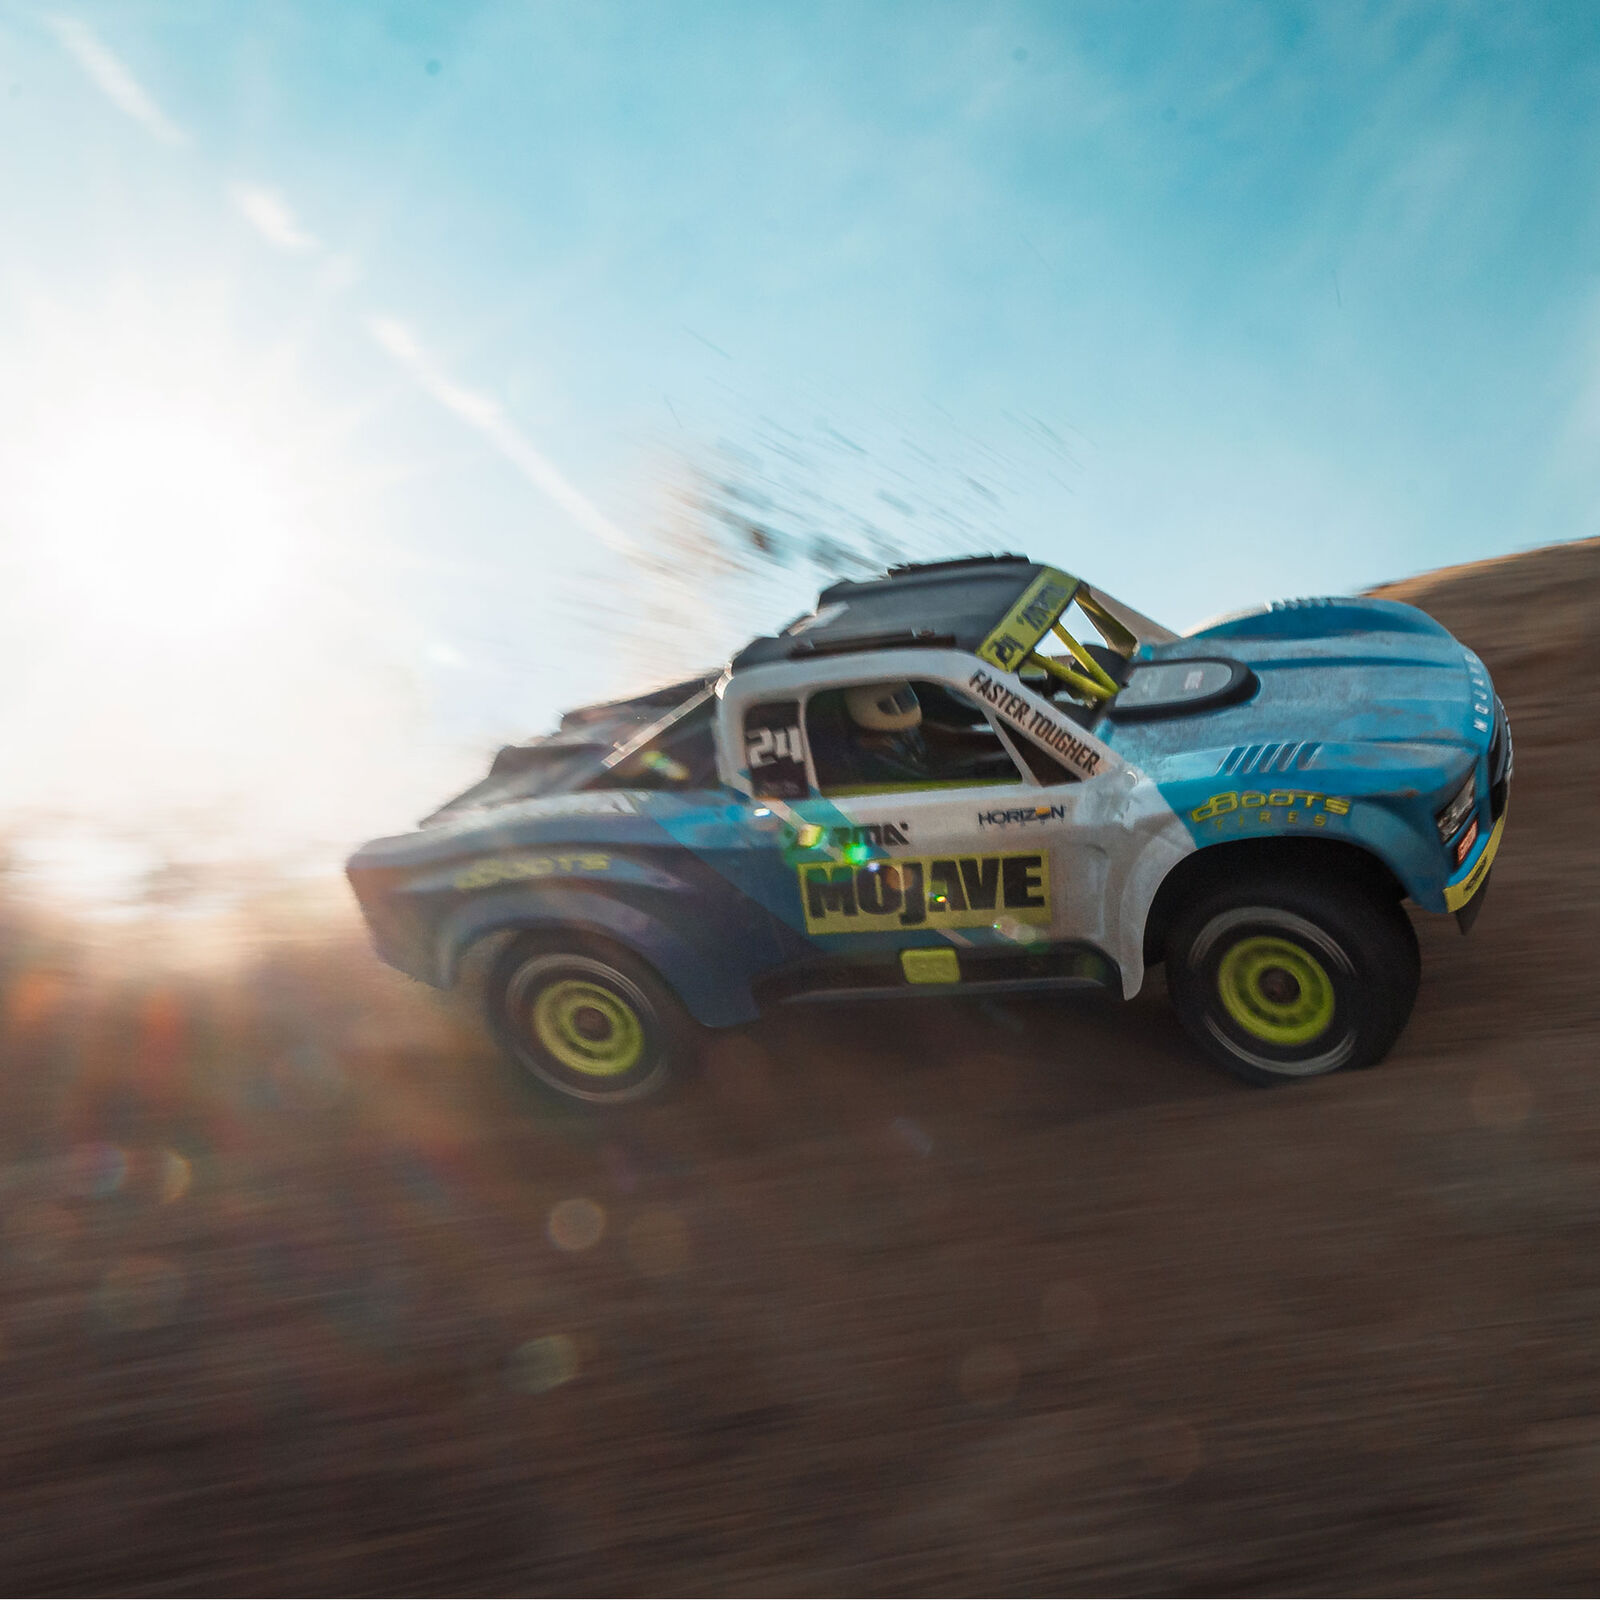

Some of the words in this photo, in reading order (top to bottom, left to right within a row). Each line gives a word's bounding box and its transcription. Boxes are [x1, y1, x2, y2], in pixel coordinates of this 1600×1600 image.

[744, 726, 804, 769] 24
[1028, 710, 1101, 776] TOUGHER.
[806, 855, 1046, 926] MOJAVE
